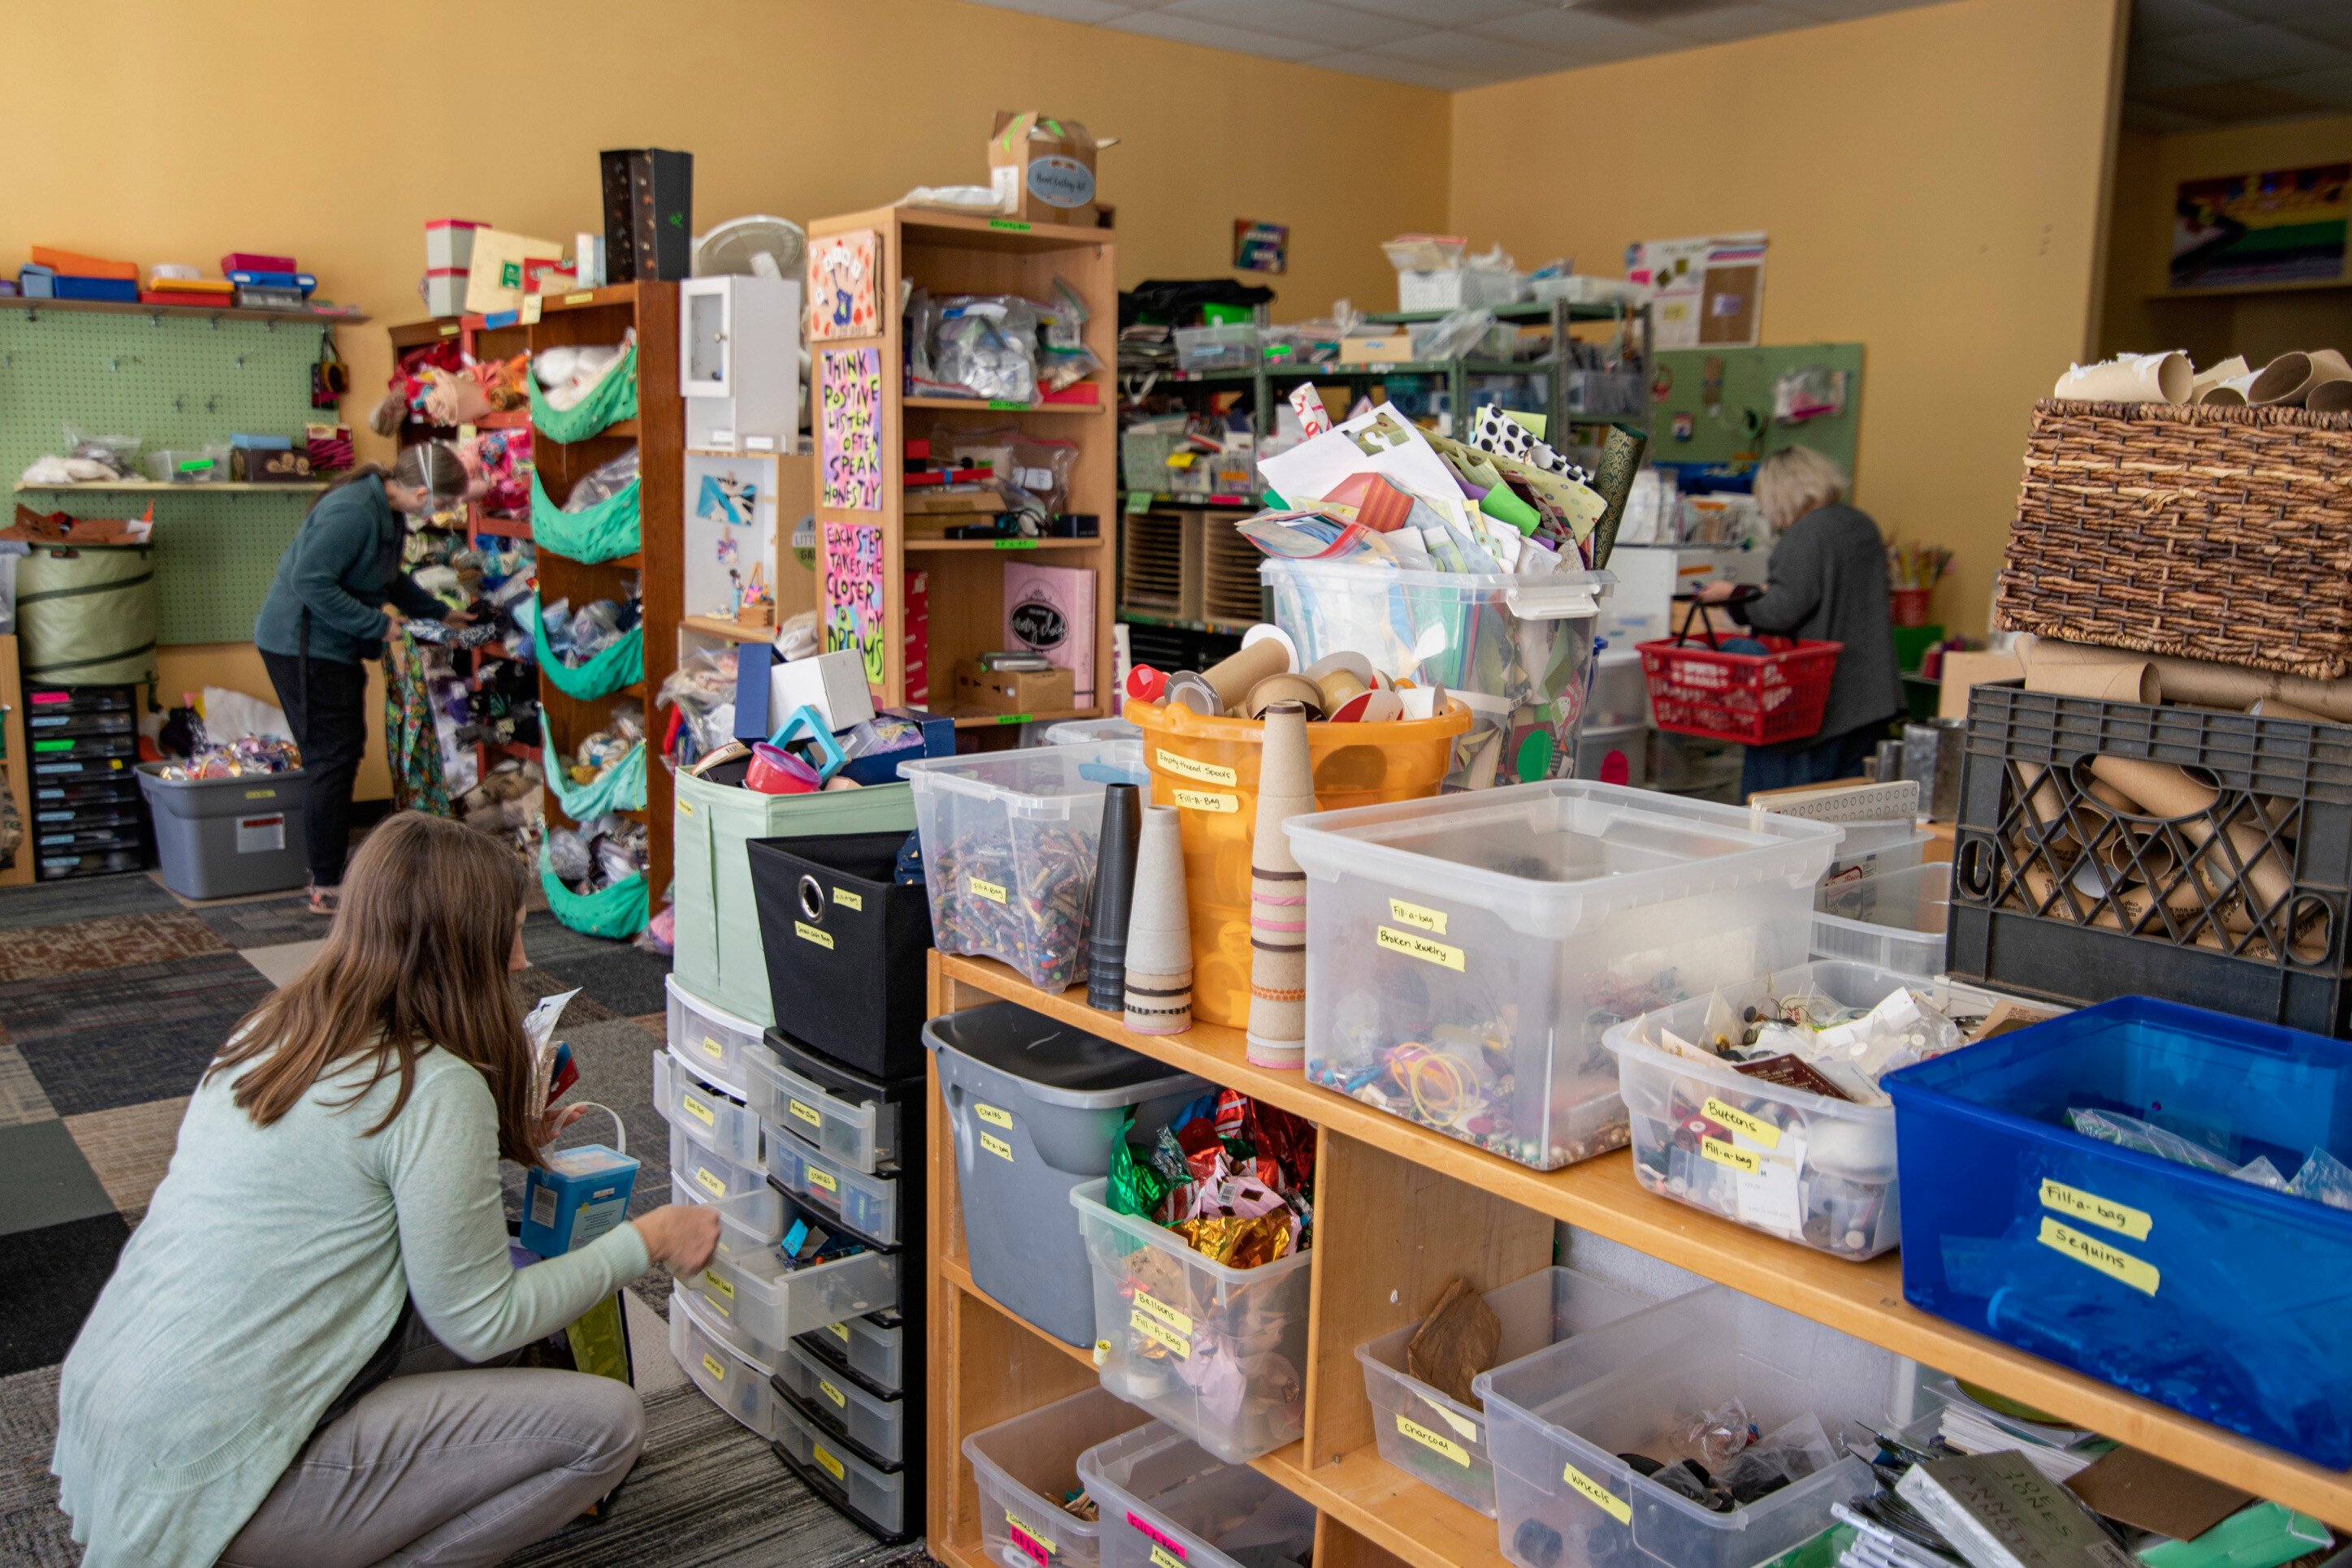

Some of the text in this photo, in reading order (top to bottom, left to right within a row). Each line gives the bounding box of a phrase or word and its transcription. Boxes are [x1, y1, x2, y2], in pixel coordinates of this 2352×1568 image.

[825, 351, 868, 381] THINK
[825, 379, 879, 409] POSITIVE
[828, 412, 871, 434] LISTEN
[843, 432, 880, 452] OFTEN
[830, 456, 879, 482] SPEAK
[824, 481, 880, 508] HONESTLY
[827, 528, 881, 555] EACH STEP
[830, 553, 861, 577] TAKES
[867, 558, 883, 575] ME
[827, 572, 875, 609] CLOSER
[834, 604, 884, 634] TO MY
[1160, 753, 1230, 779] Empty thread Spools
[1178, 793, 1220, 810] Fill-A-Bag
[1393, 905, 1434, 931] Fill-a-bag
[1381, 930, 1446, 961] Broken Jewelry
[1708, 1101, 1758, 1132] Buttons
[1706, 1142, 1753, 1169] Fill-a-bag
[2046, 1185, 2127, 1228] Fill-a-bag
[2056, 1228, 2126, 1269] Sequins
[1139, 1293, 1174, 1321] Balloons
[2008, 1468, 2057, 1506] JOE
[1961, 1474, 2027, 1530] ANNE
[1995, 1470, 2073, 1538] JONES
